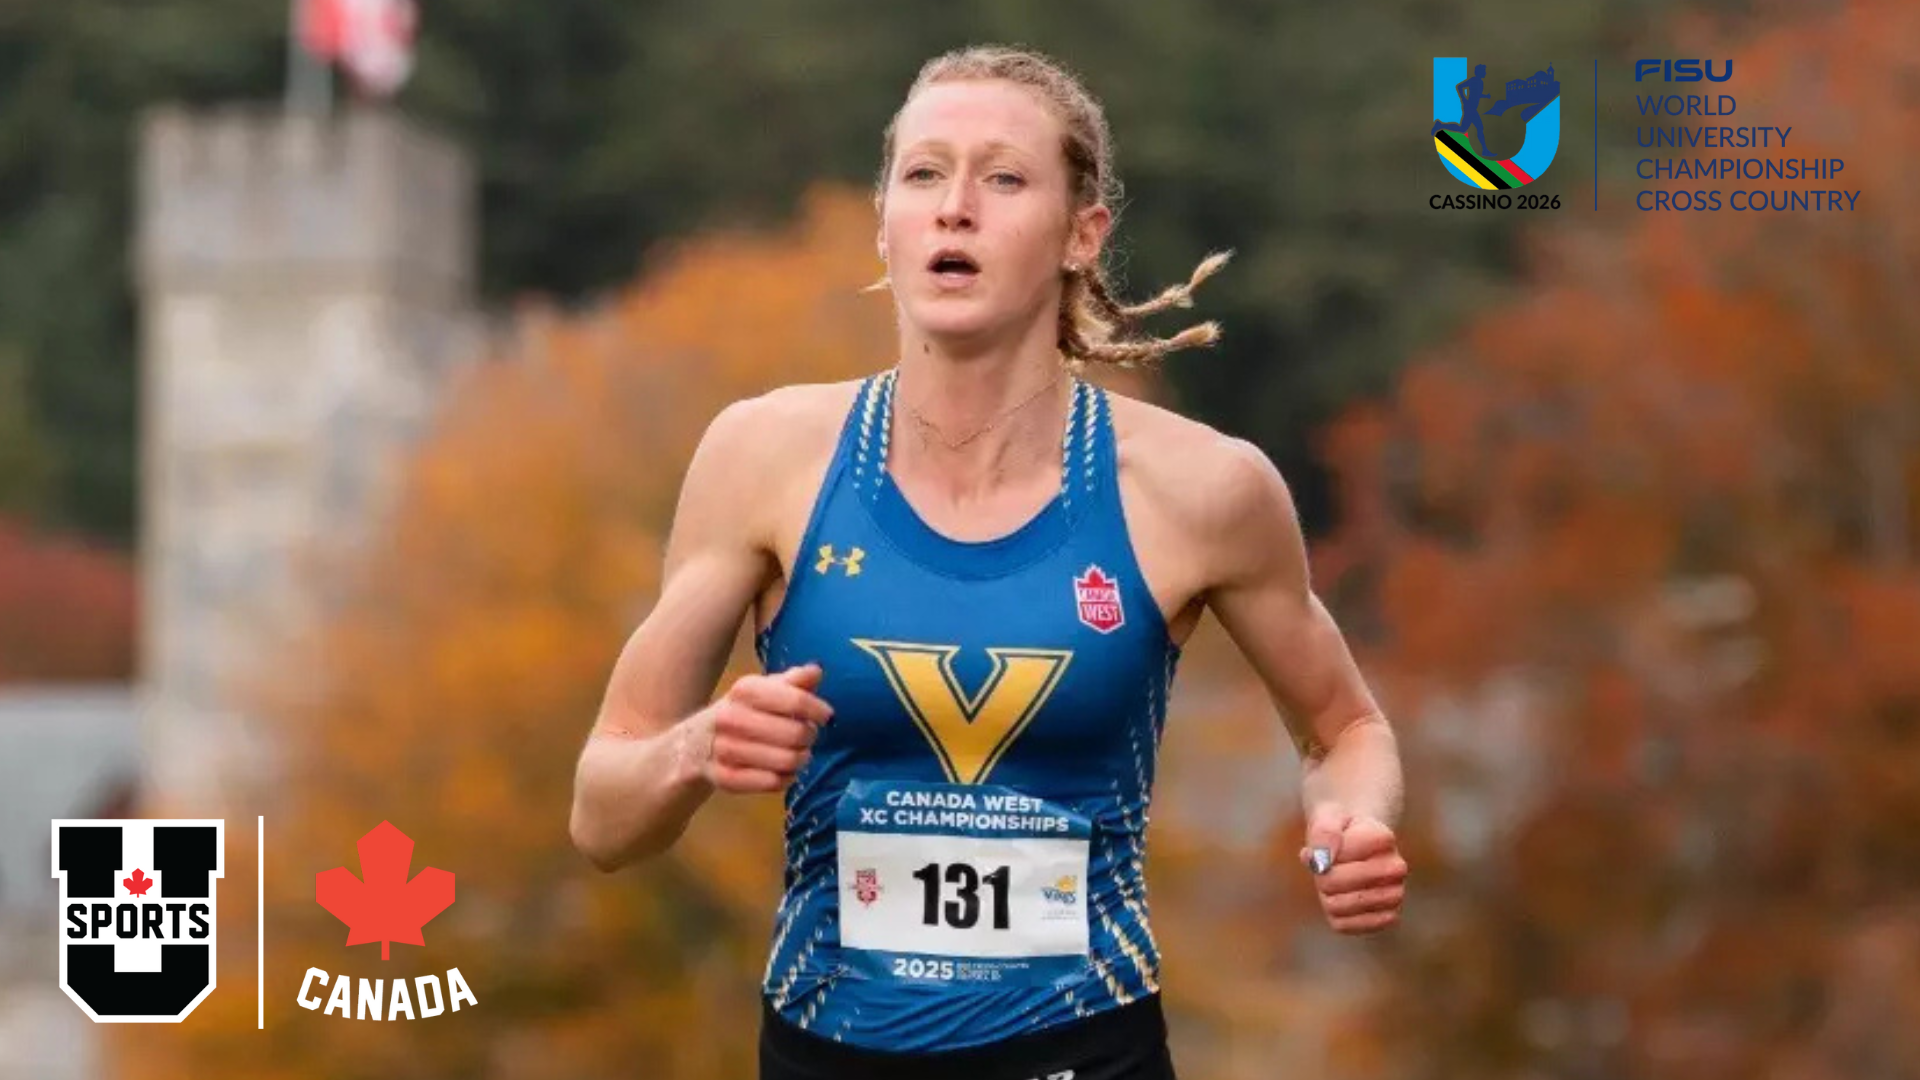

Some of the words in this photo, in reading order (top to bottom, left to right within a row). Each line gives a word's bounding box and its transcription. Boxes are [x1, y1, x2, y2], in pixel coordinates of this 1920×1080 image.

[1081, 603, 1118, 621] WEST
[851, 638, 1074, 784] V
[886, 791, 976, 809] CANADA
[983, 796, 1044, 813] WEST
[860, 808, 888, 824] XC
[894, 812, 1070, 832] CHAMPIONSHIPS
[912, 863, 1010, 929] 131
[892, 958, 954, 980] 2025
